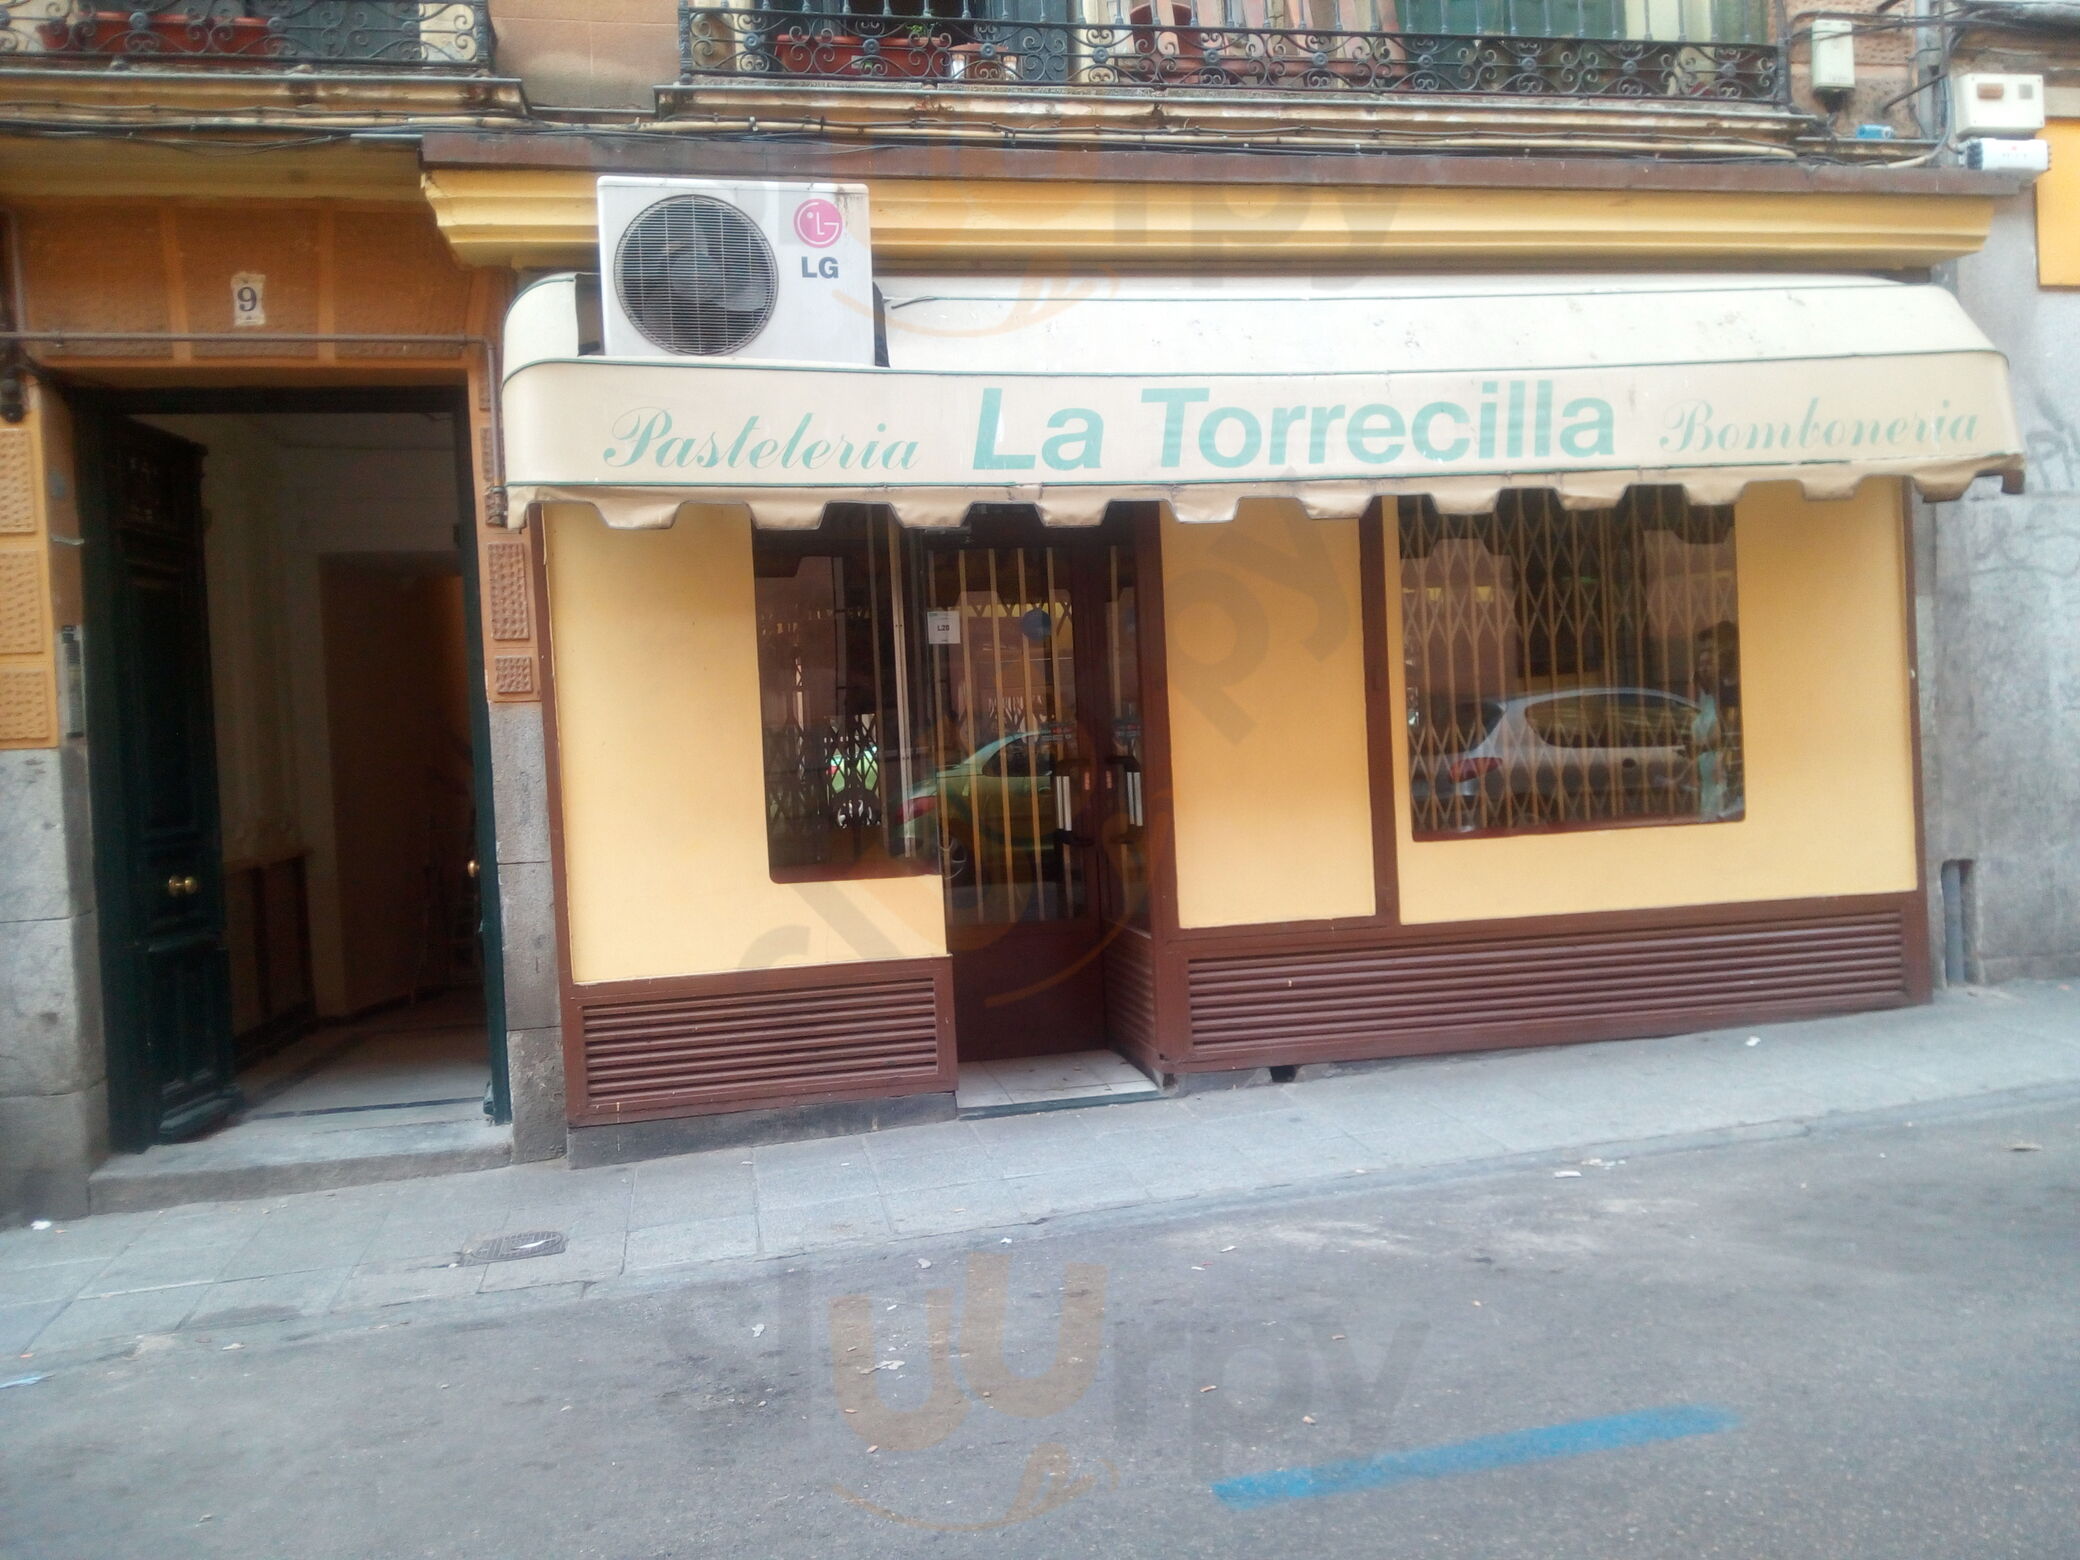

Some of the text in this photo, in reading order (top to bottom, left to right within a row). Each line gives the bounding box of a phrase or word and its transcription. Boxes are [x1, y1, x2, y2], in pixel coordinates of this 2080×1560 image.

[801, 256, 839, 278] LG
[237, 286, 257, 312] 9
[603, 406, 920, 470] Pasteleria
[972, 380, 1615, 471] La Torrecilla
[1658, 397, 1978, 452] Bomboneria
